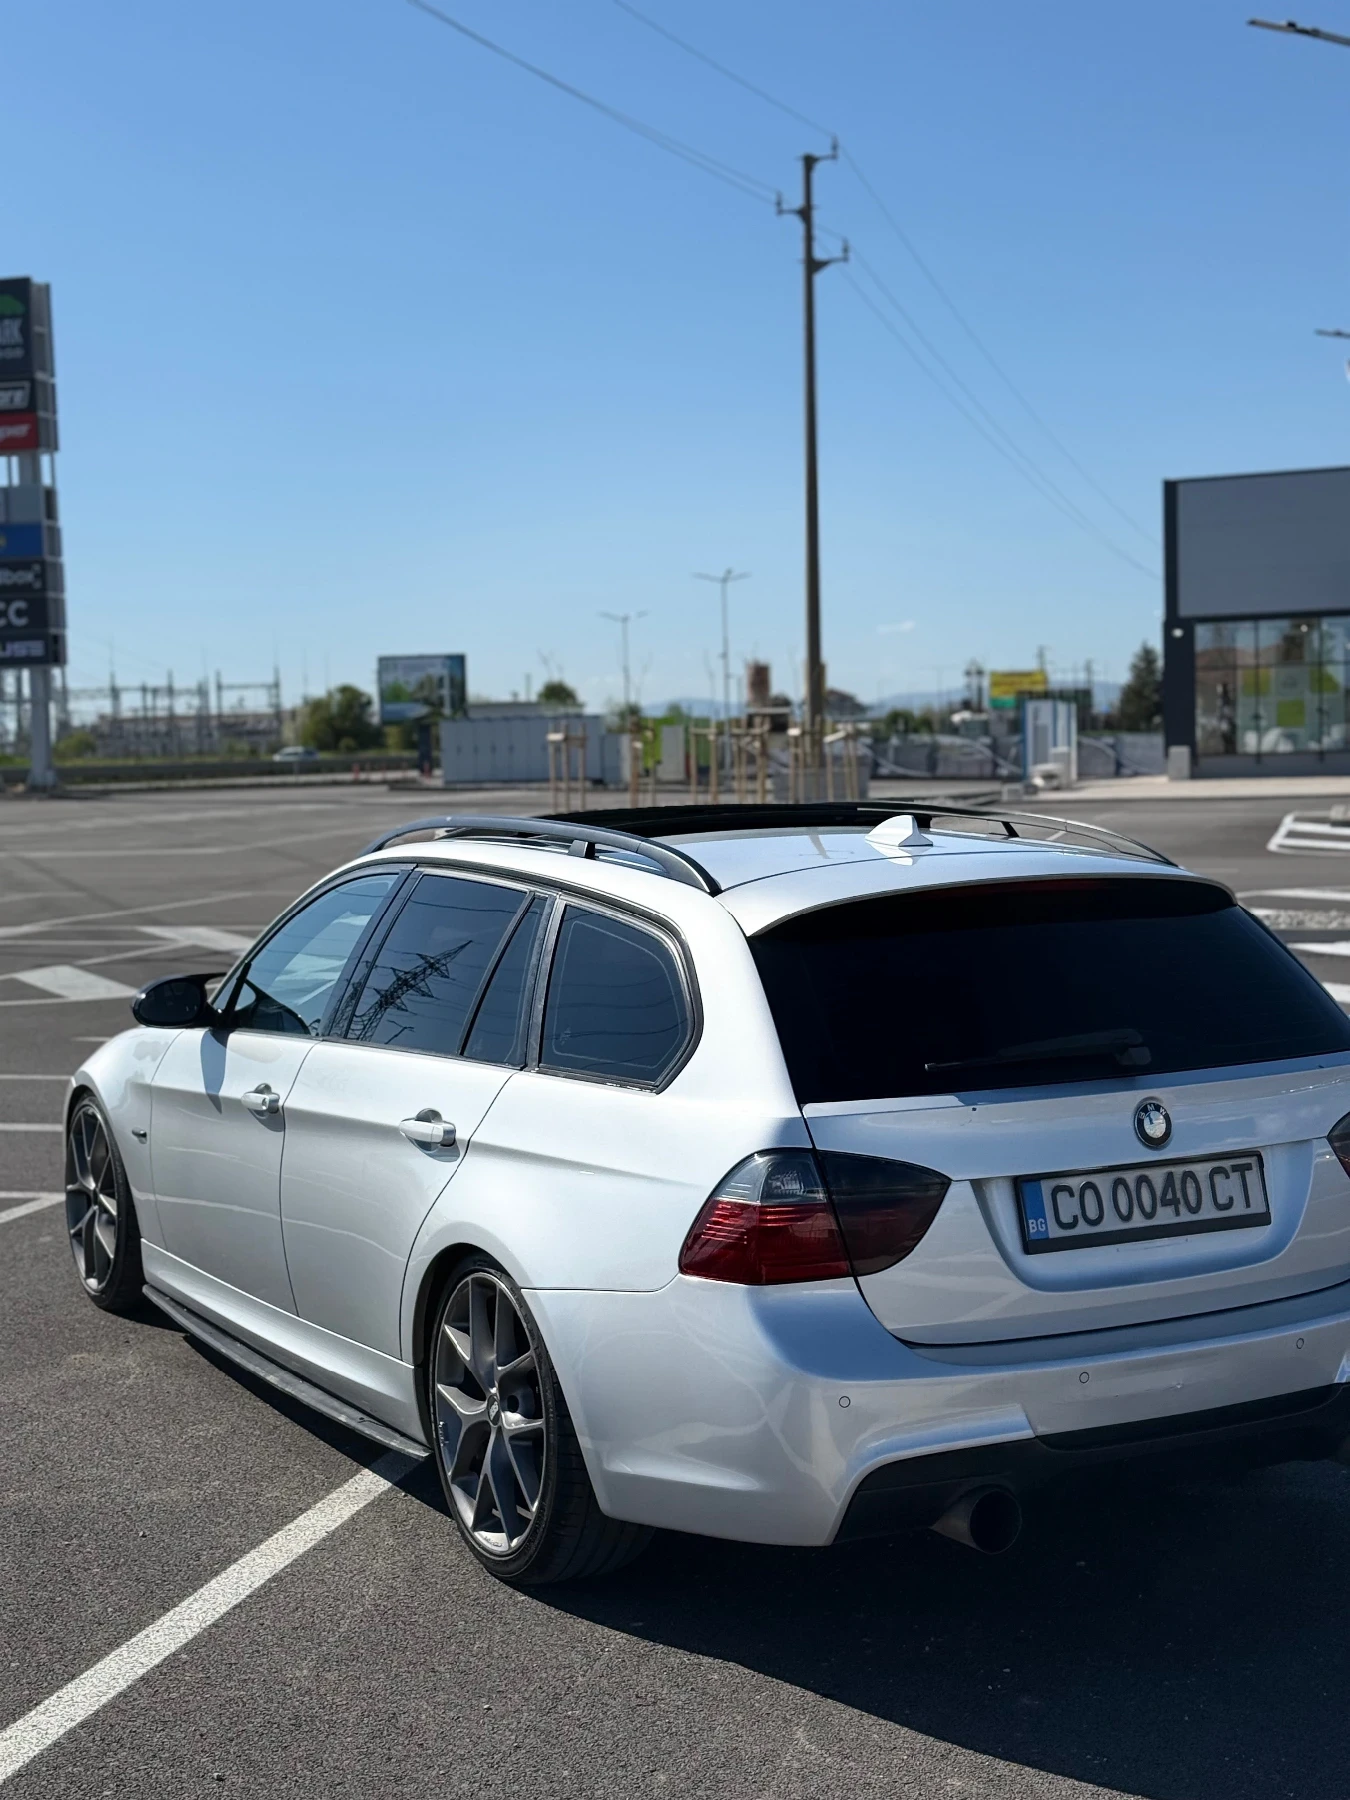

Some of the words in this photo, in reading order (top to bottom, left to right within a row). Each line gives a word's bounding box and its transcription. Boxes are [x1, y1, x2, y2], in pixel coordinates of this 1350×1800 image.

[1138, 1103, 1167, 1120] BMW
[1051, 1181, 1105, 1231] CO
[1112, 1169, 1202, 1223] 0040
[1208, 1162, 1253, 1212] CT
[1028, 1217, 1047, 1234] BG
